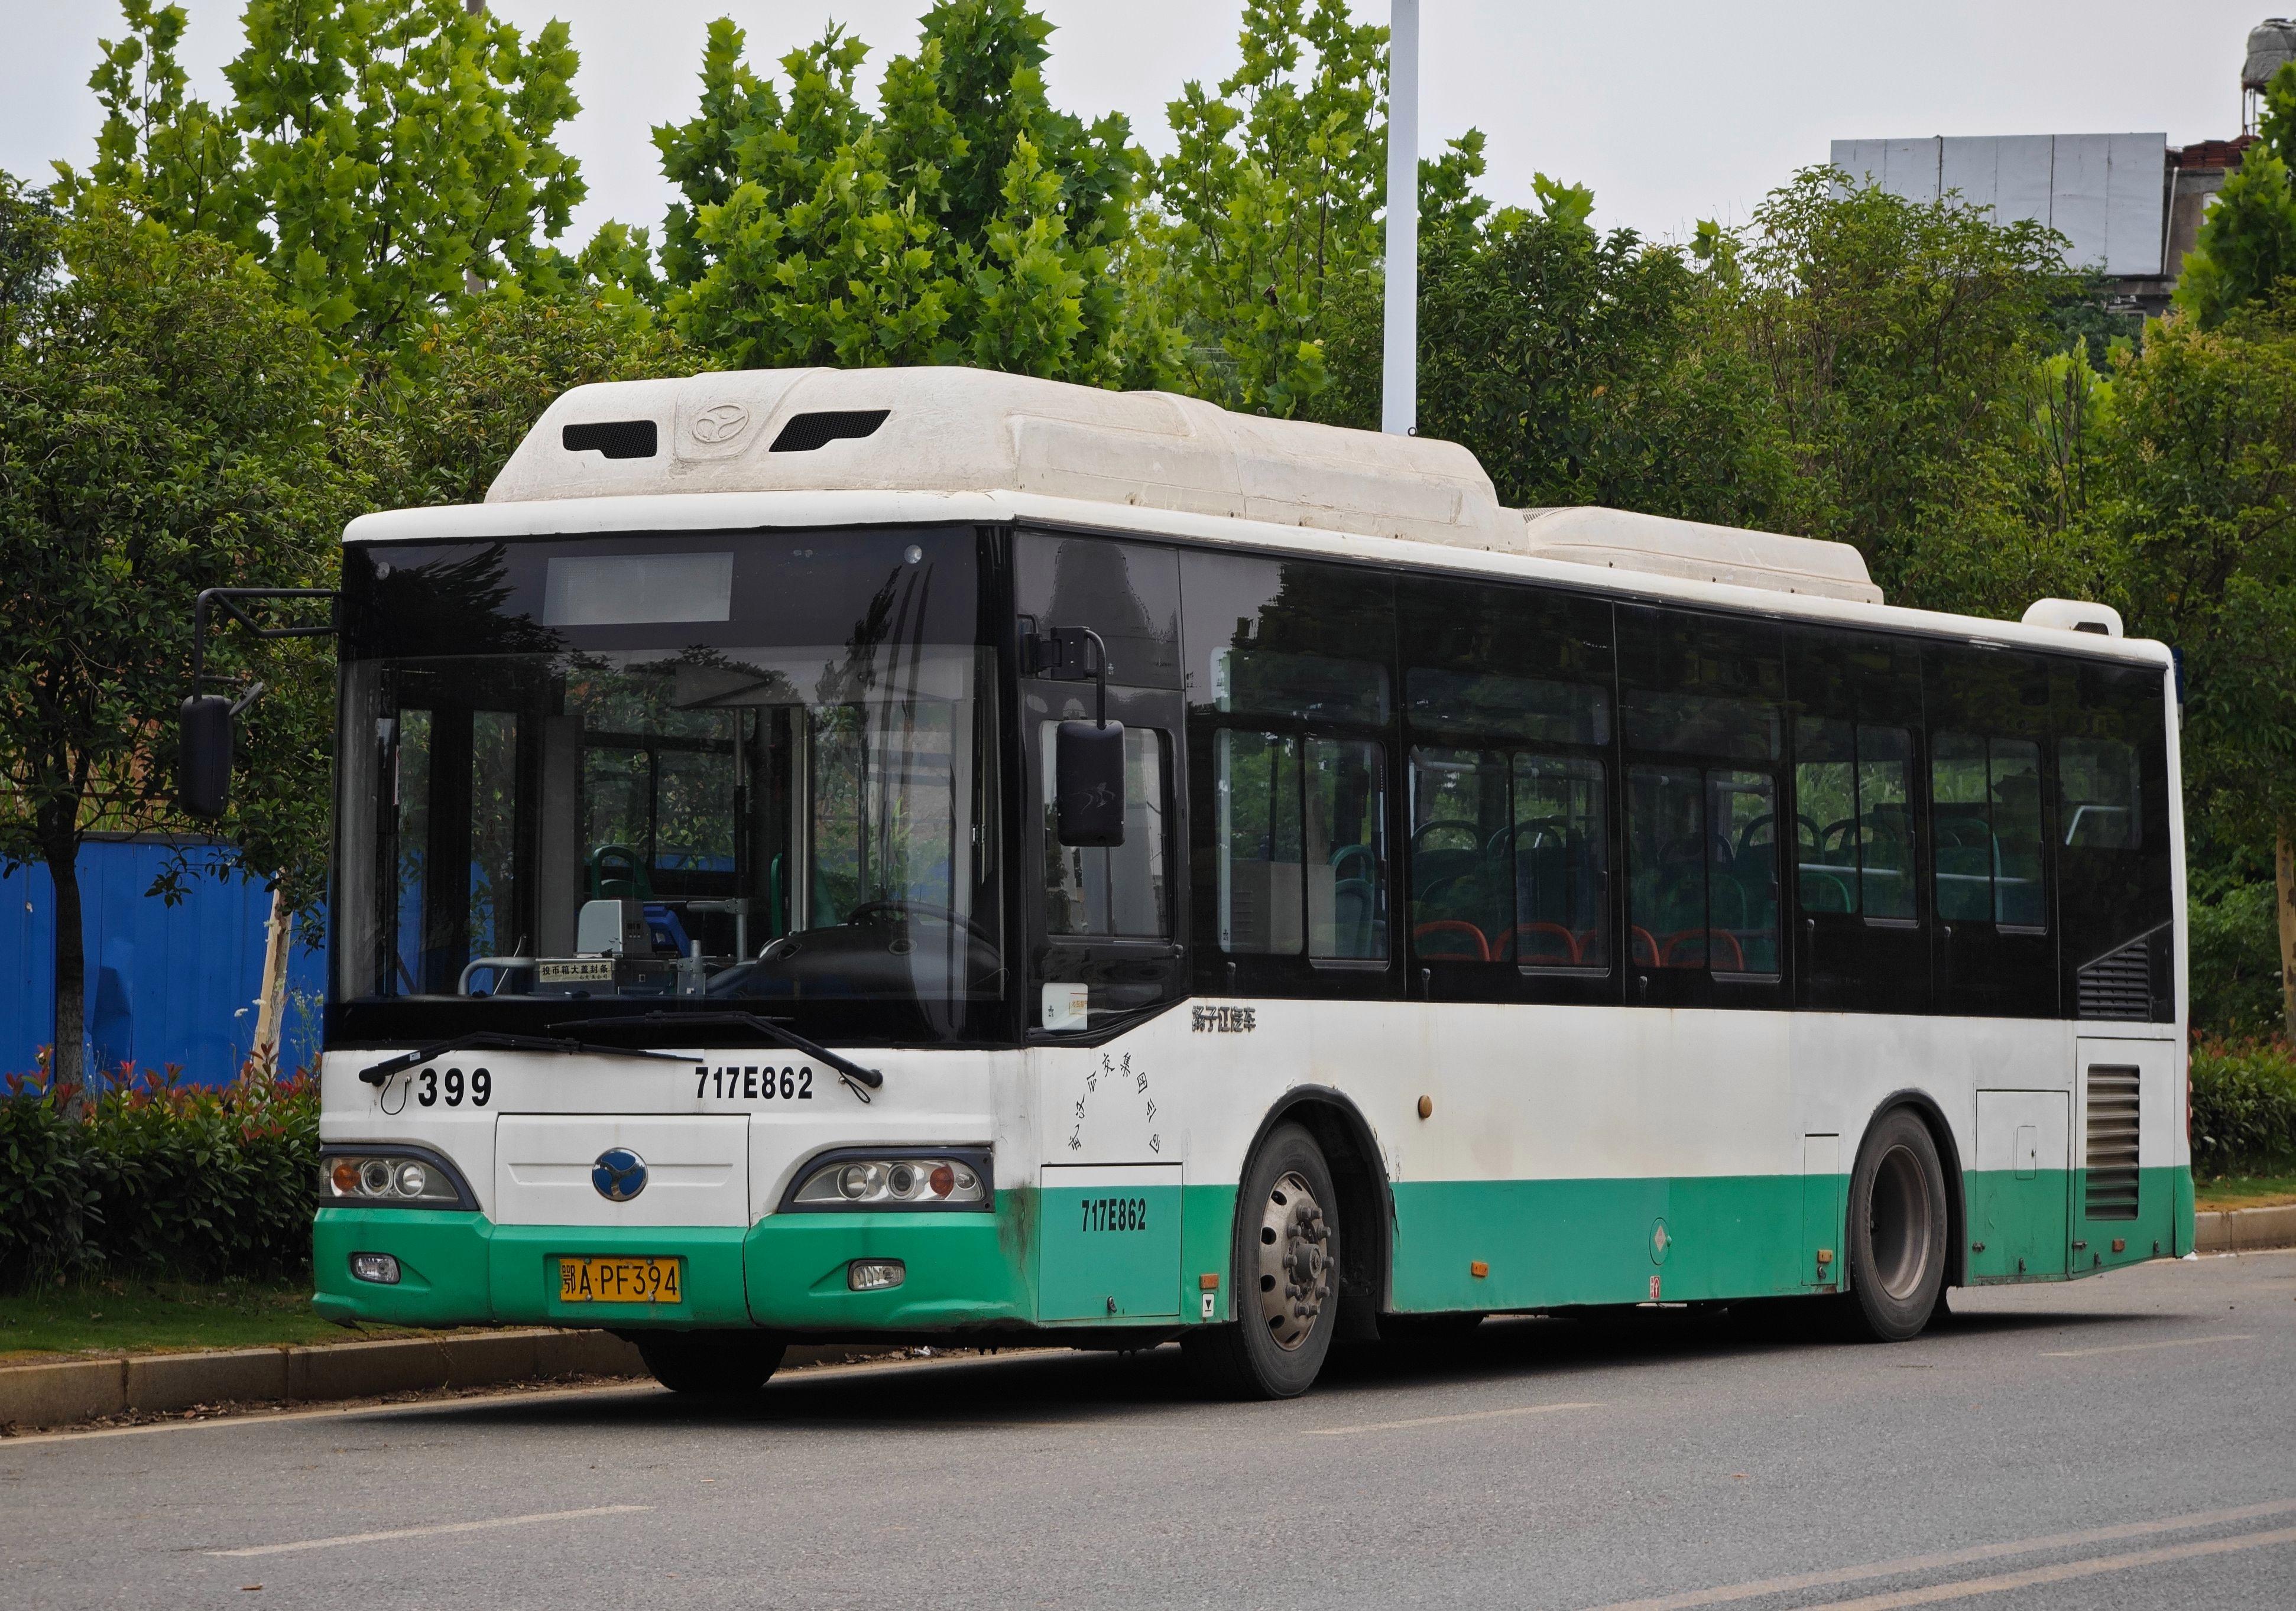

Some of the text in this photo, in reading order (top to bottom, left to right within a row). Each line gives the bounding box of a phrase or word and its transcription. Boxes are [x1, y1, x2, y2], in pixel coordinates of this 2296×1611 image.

[542, 964, 608, 975] 投币箱大盖封条
[1191, 1005, 1256, 1032] 扬子江汽车
[418, 1067, 491, 1107] 399
[695, 1066, 813, 1099] 717E862
[1082, 1198, 1146, 1232] 717E862
